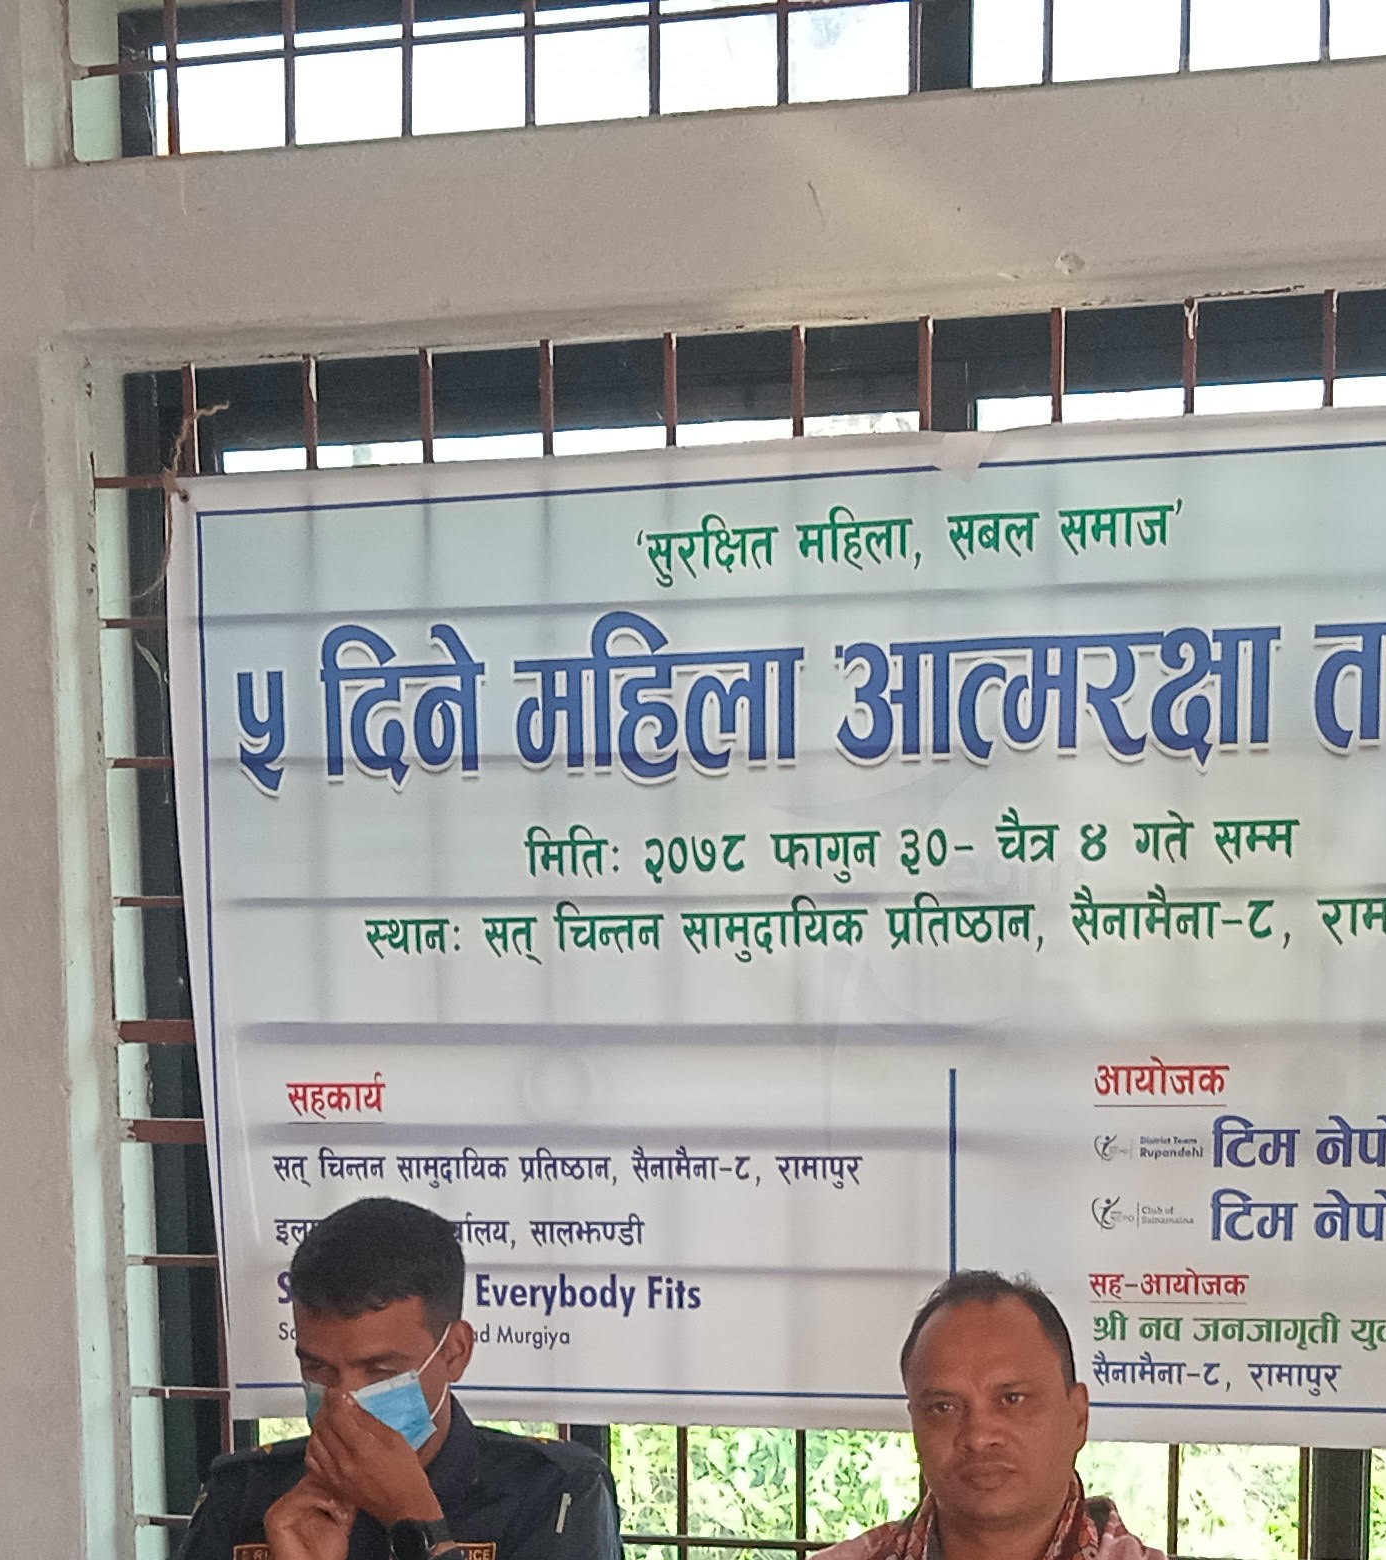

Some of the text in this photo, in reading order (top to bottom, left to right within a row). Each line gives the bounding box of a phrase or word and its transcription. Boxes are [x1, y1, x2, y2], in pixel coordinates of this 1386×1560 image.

[795, 505, 922, 572] महिला,
[946, 511, 1041, 561] सबल
[236, 670, 287, 797] ५
[318, 623, 485, 789] दिने
[511, 610, 805, 784] महिला
[834, 625, 1282, 769] आत्मरक्षा
[644, 833, 747, 884] २०७८
[769, 830, 882, 884] फागुन
[994, 806, 1061, 863] चैत्र
[1080, 823, 1108, 862] ४
[1132, 809, 1195, 864] गते
[1212, 818, 1301, 864] सम्म
[481, 916, 543, 966] सत्
[552, 897, 665, 954] चिन्तन
[679, 893, 872, 963] सामुदायिक
[884, 891, 1044, 953] प्रतिष्ठान,
[285, 1071, 387, 1120] सहकार्य
[1094, 1055, 1230, 1096] आयोजक
[1211, 1114, 1301, 1168] टिम
[272, 1155, 311, 1188] सत्
[317, 1146, 387, 1181] चिन्तन
[396, 1146, 510, 1189] सामुदायिक
[518, 1146, 617, 1186] प्रतिष्ठान,
[774, 1155, 864, 1190] रामापुर
[1210, 1188, 1299, 1242] टिम
[475, 1272, 701, 1318] Everybody Fits
[1088, 1267, 1250, 1300] सह-आयोजक
[496, 1325, 570, 1351] Murgiya
[1093, 1309, 1129, 1342] श्री
[1138, 1316, 1184, 1342] नव
[1247, 1363, 1343, 1397] रामापुर
